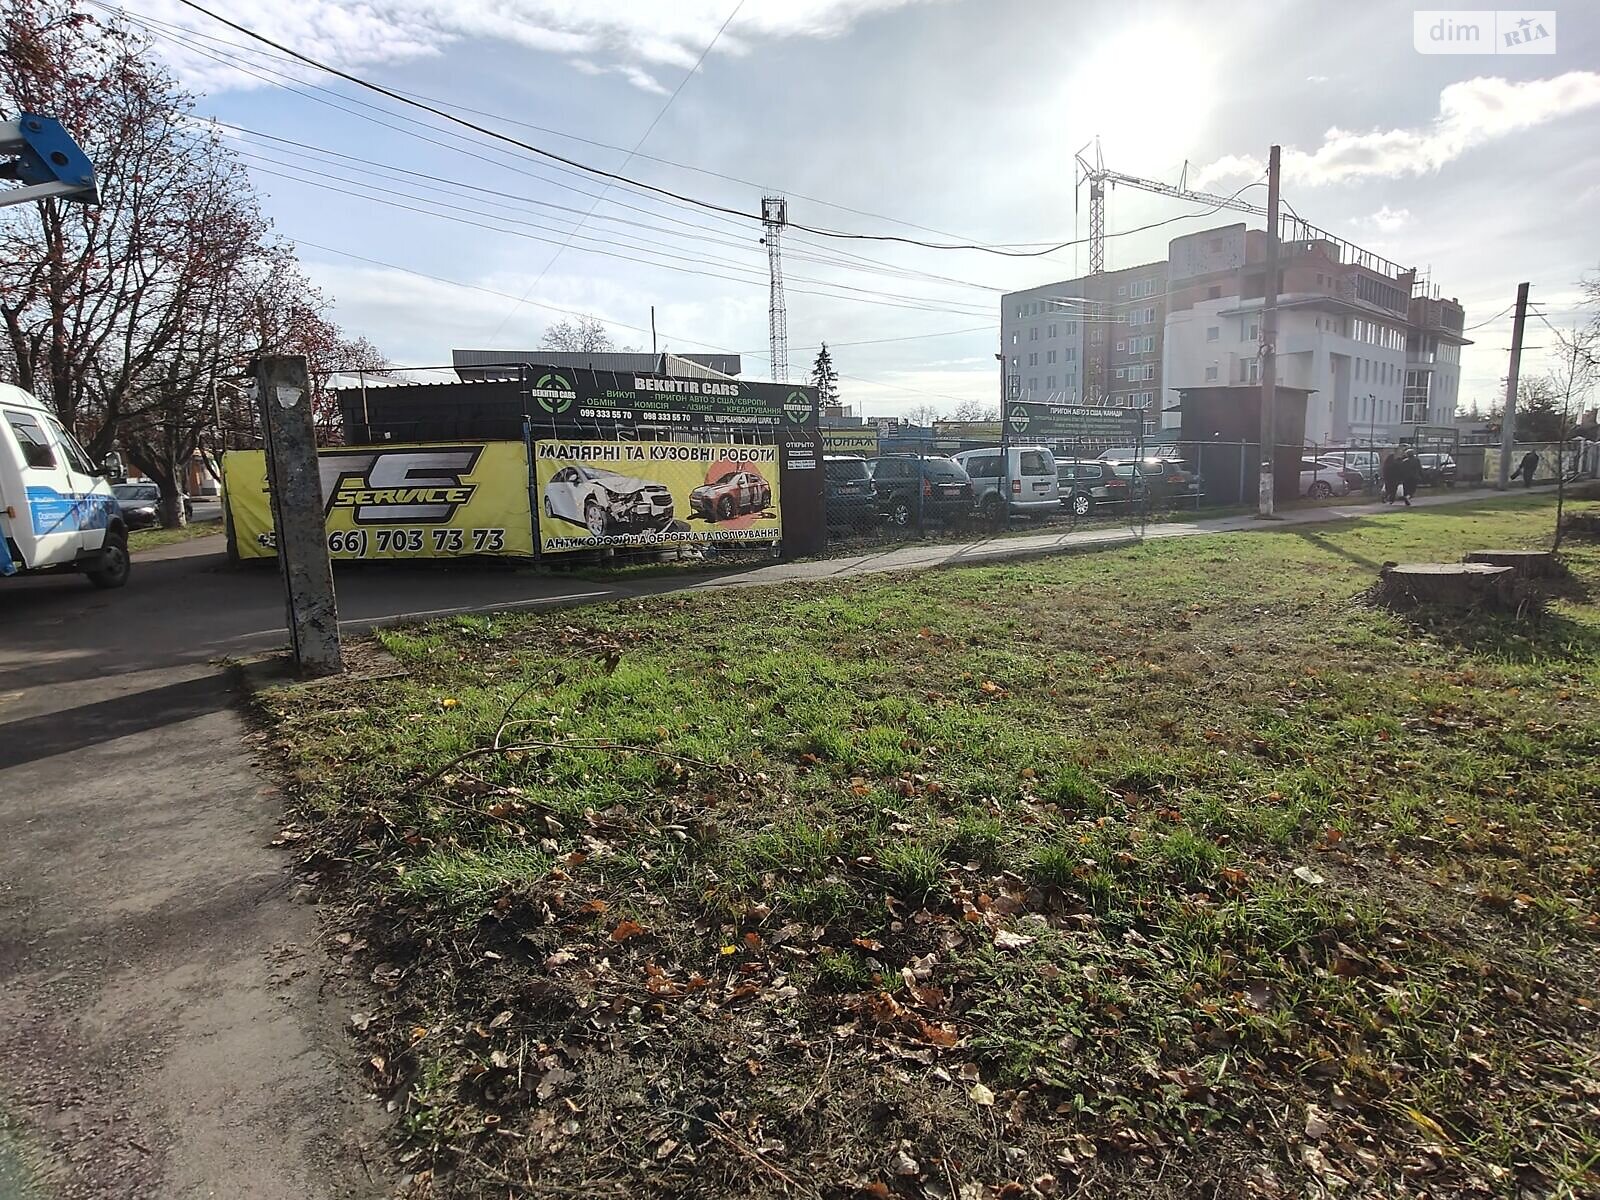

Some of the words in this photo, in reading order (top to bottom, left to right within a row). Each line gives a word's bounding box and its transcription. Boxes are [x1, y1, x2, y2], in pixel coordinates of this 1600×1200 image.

[559, 390, 576, 399] CARS
[634, 377, 699, 393] BEKHTIR
[702, 382, 739, 396] CARS
[689, 395, 708, 403] АВТО
[580, 409, 595, 417] 099
[596, 409, 611, 418] 333
[611, 410, 621, 418] 55
[622, 411, 632, 419] 70
[658, 412, 671, 420] 333
[672, 413, 681, 421] 55
[682, 413, 691, 421] 70
[539, 444, 620, 460] МАЛЯРНІ
[625, 446, 645, 460] ТА
[649, 446, 715, 461] КУЗОВНІ
[719, 448, 775, 461] РОБОТИ
[334, 487, 472, 505] SERVICE
[328, 530, 368, 557] 66)
[376, 530, 424, 551] 703
[432, 529, 464, 551] 73
[472, 529, 505, 550] 73
[648, 532, 700, 544] ОБРОБКА
[701, 531, 714, 541] ТА
[715, 528, 779, 540] ПОЛІРУВАННЯ
